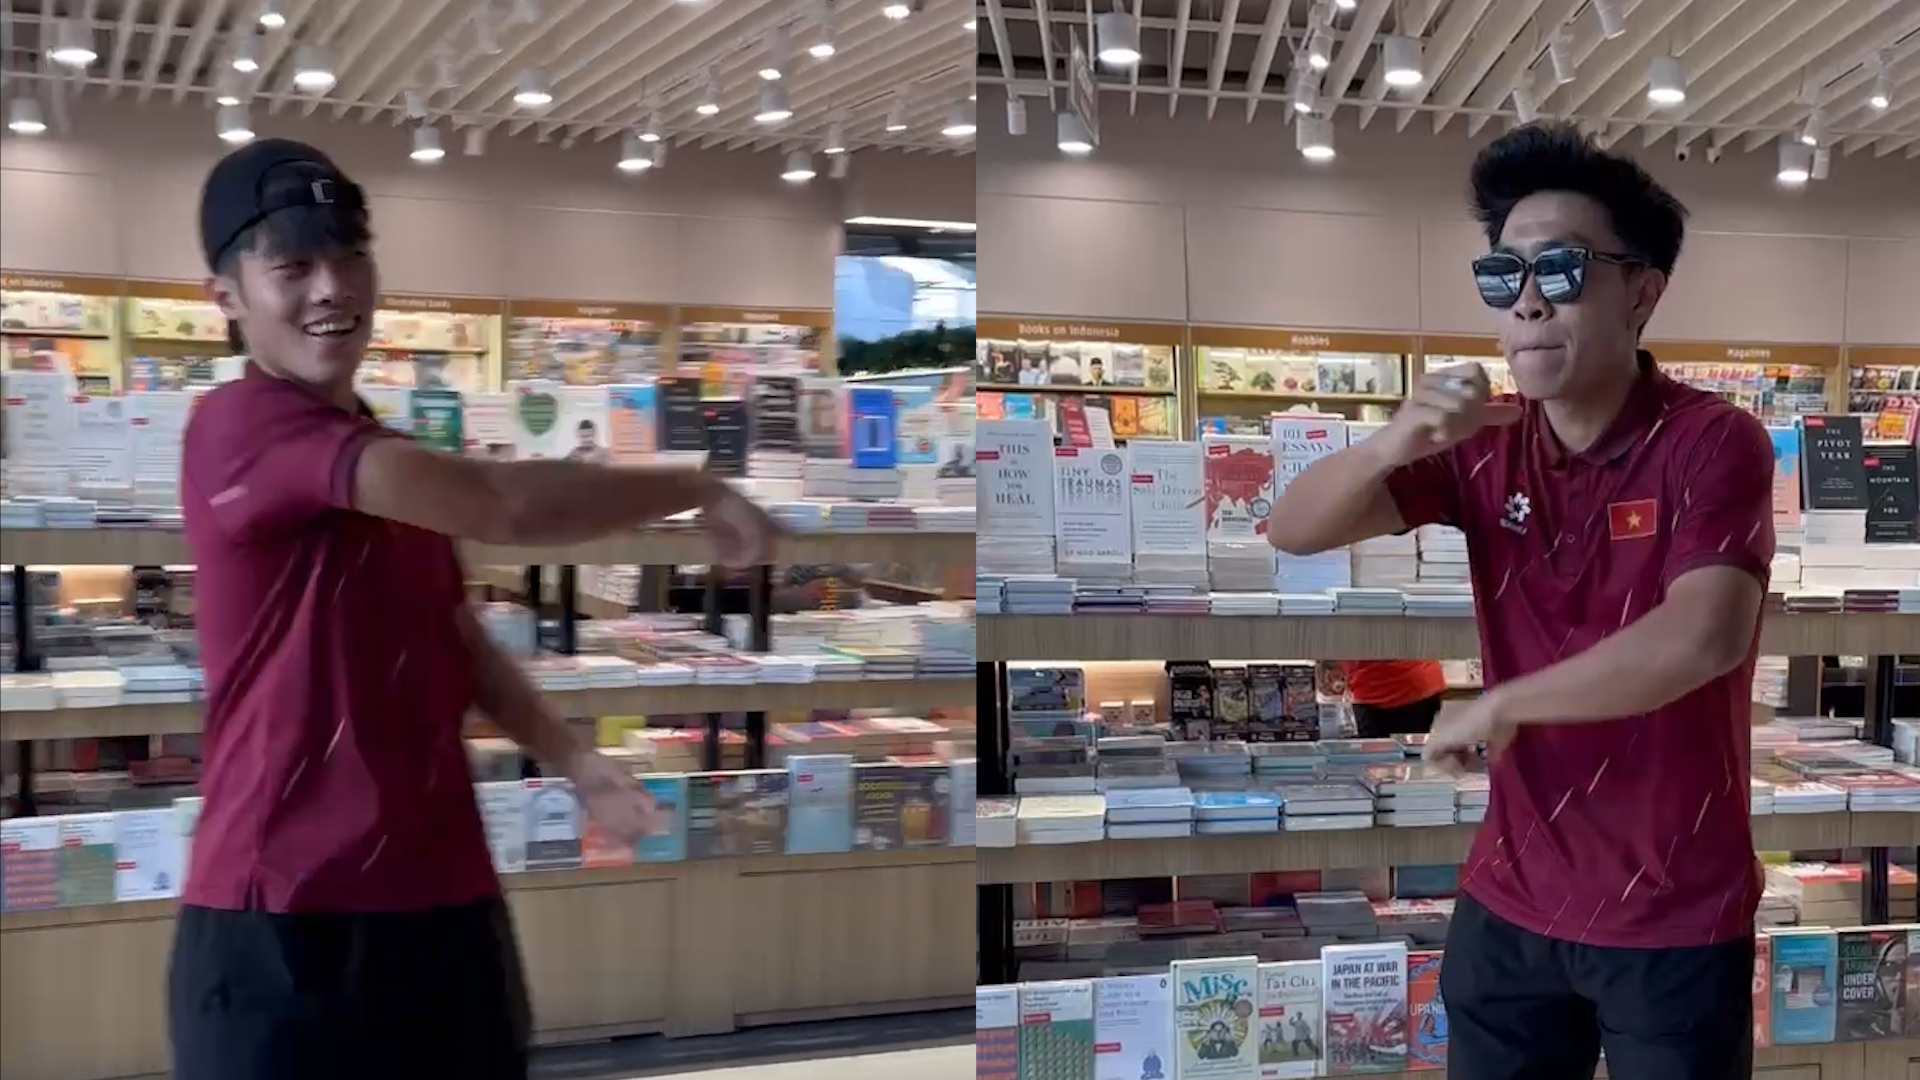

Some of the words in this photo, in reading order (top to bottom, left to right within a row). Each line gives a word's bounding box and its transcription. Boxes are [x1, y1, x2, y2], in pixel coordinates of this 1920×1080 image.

[1018, 323, 1050, 334] Books
[1052, 326, 1067, 335] on
[1069, 325, 1120, 337] Indonesia
[1000, 444, 1031, 455] THIS
[1282, 442, 1333, 452] ESSAYS
[1817, 440, 1851, 448] PIVOT
[1820, 452, 1850, 460] YEAR
[998, 469, 1029, 479] HOW
[1061, 467, 1090, 477] TINY
[1061, 478, 1121, 494] TRAUMAS
[995, 493, 1036, 505] HEAL
[1332, 964, 1361, 976] JAPAN
[1363, 963, 1374, 973] AT
[1377, 961, 1398, 972] WAR
[1331, 979, 1341, 990] IN
[1344, 977, 1361, 989] THE
[1363, 975, 1400, 987] PACIFIC
[1843, 973, 1876, 986] UNDER
[1843, 986, 1875, 1000] COVER
